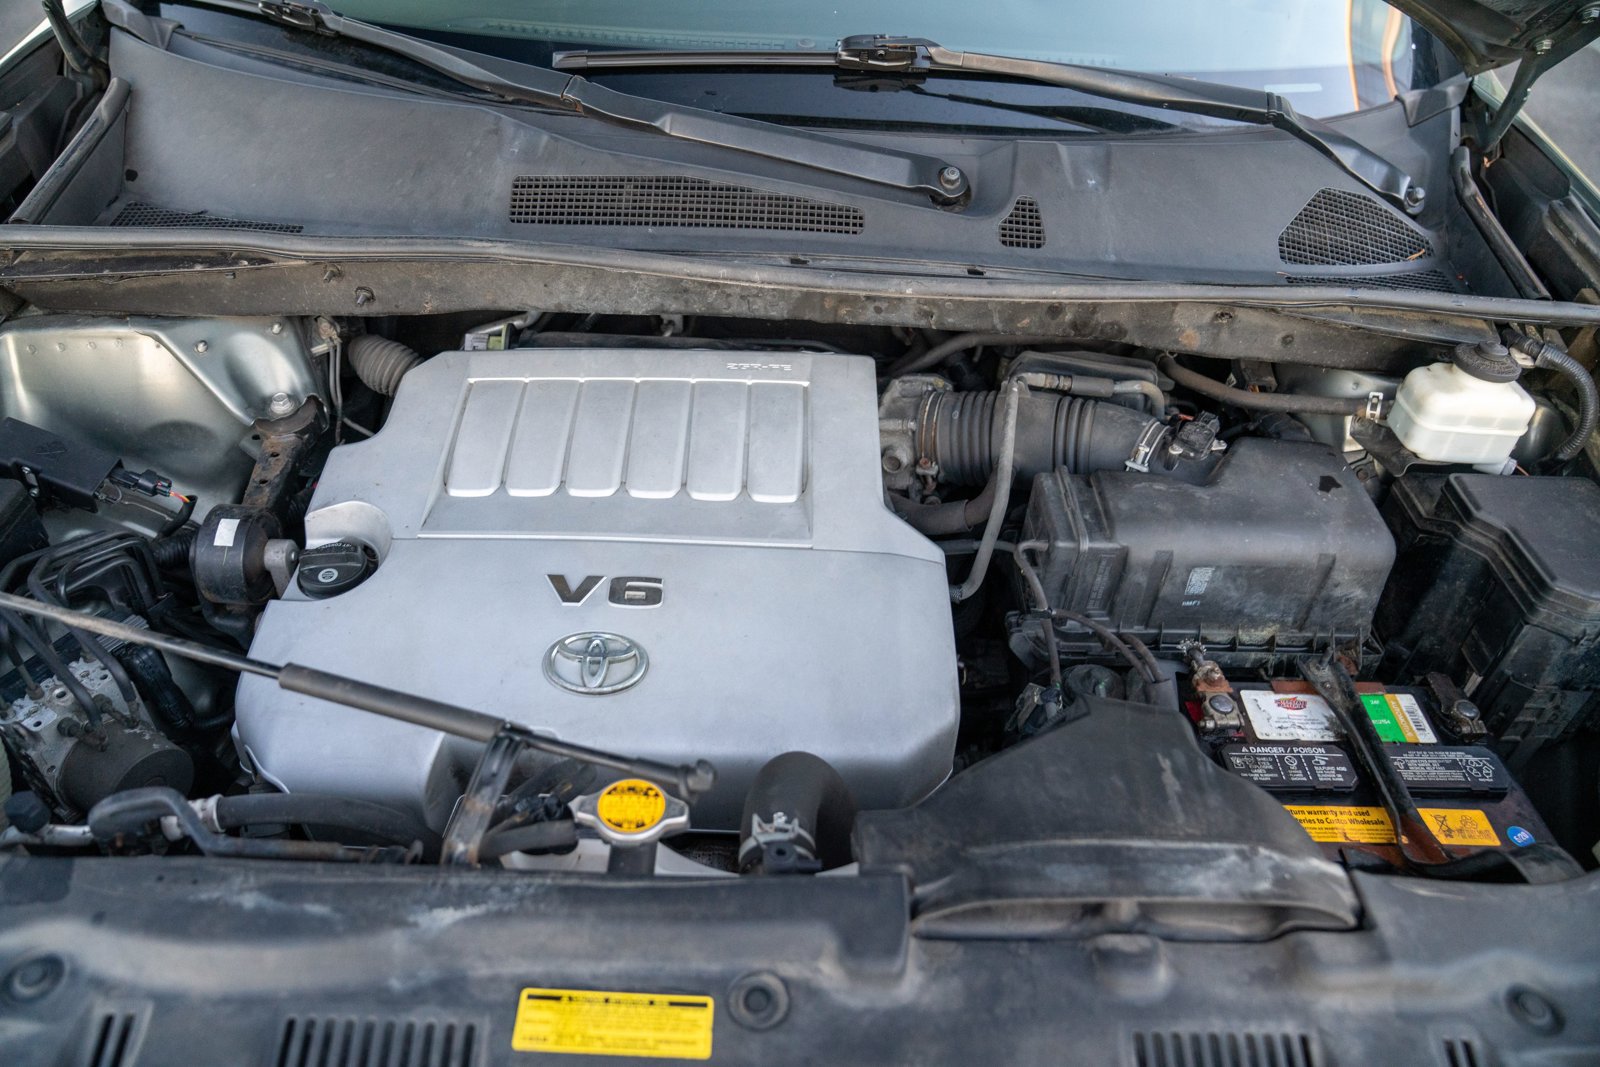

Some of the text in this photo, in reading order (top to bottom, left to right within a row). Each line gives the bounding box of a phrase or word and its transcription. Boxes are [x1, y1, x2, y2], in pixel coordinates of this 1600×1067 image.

[545, 574, 663, 609] V6
[1308, 809, 1337, 817] warranty
[1349, 818, 1385, 826] Wholesale
